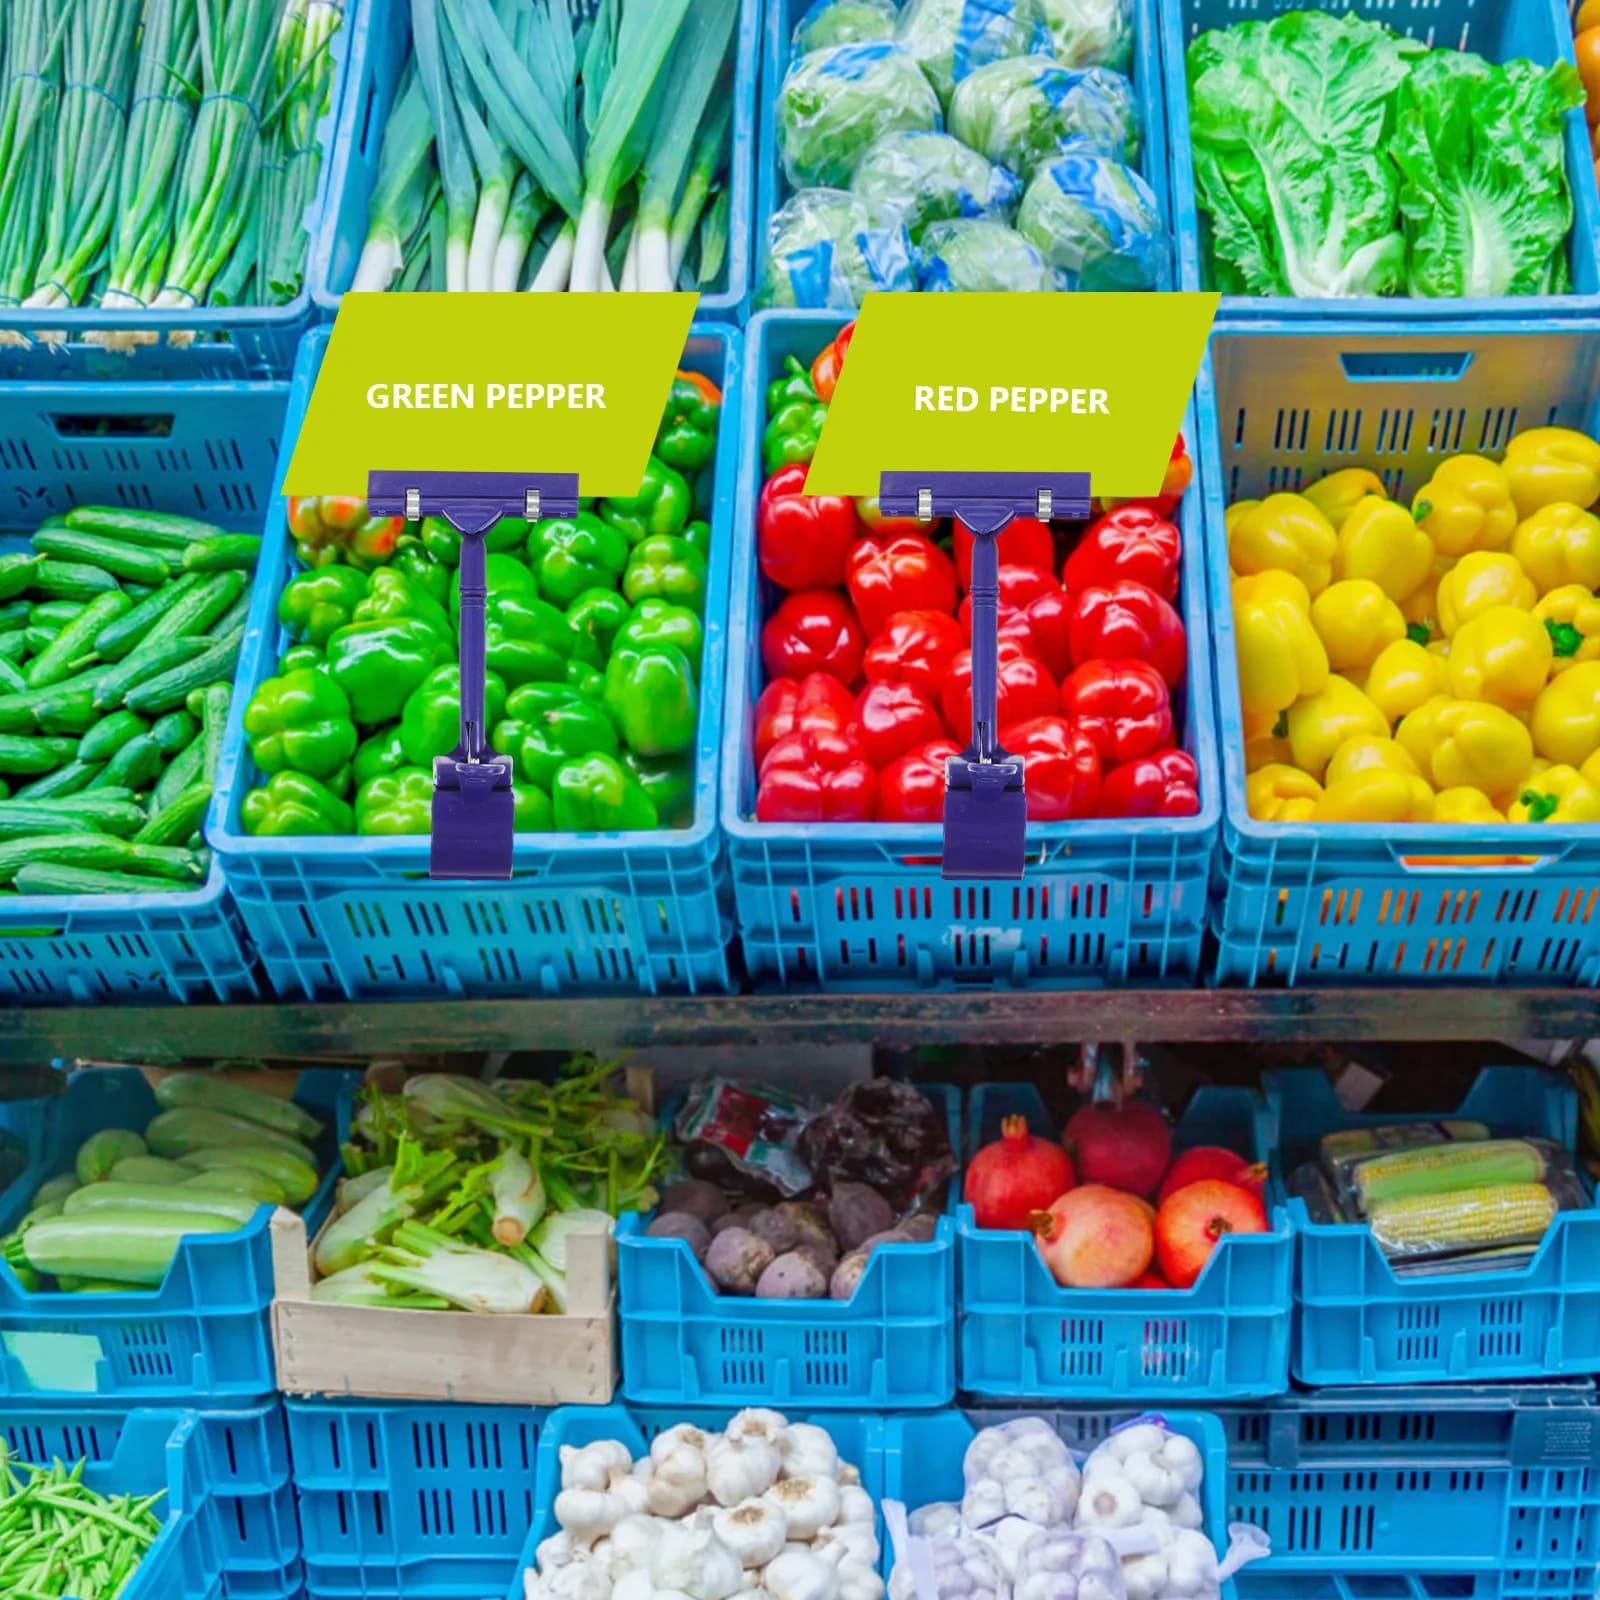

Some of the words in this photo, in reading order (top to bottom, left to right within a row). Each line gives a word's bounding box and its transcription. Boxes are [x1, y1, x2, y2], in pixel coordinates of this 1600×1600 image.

[366, 383, 475, 409] GREEN
[486, 383, 607, 409] PEPPER
[914, 385, 979, 412] RED
[990, 386, 1110, 415] PEPPER
